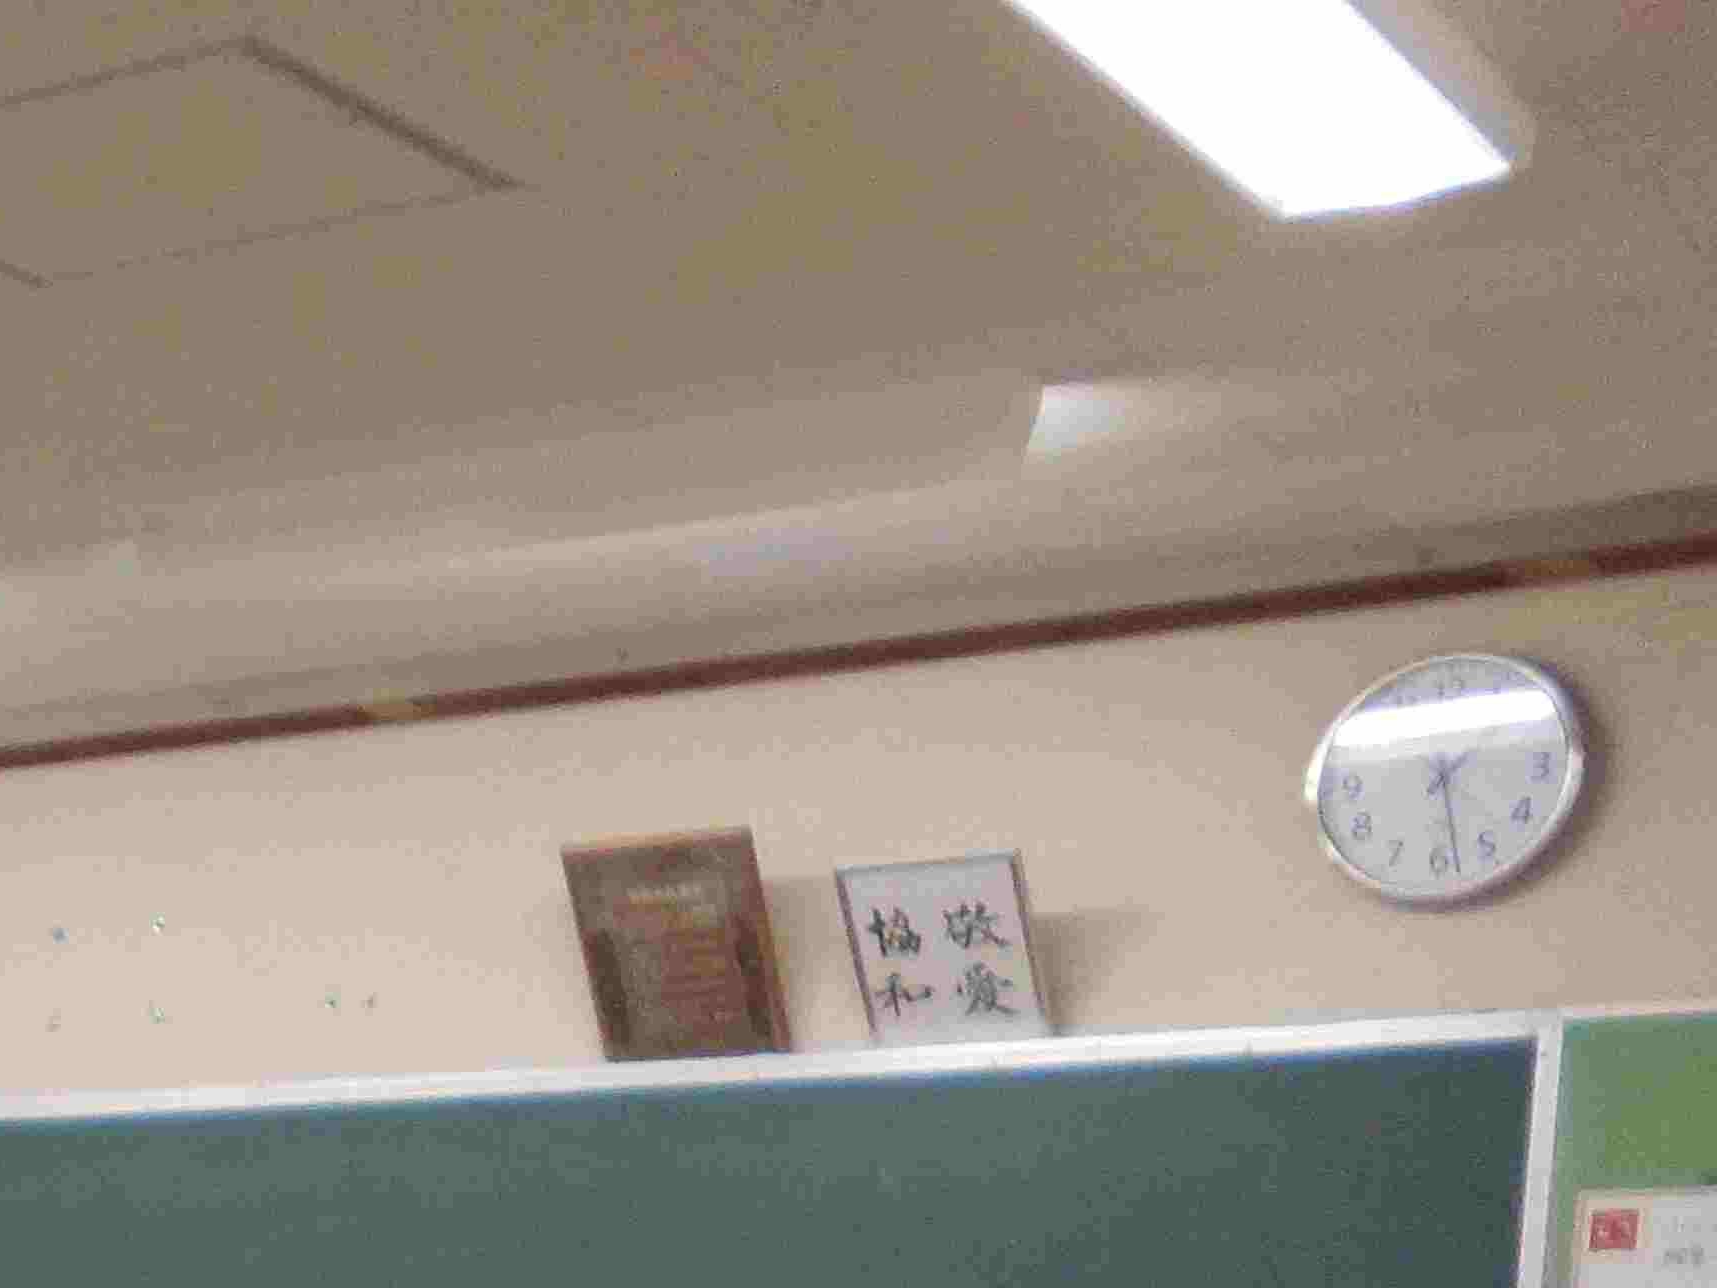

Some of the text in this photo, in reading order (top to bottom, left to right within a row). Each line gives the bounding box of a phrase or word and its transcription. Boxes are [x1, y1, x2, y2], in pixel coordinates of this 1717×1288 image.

[1533, 751, 1551, 780] 3
[1342, 774, 1363, 800] 9
[1512, 796, 1532, 824] 4
[1352, 812, 1372, 840] 8
[1388, 841, 1405, 867] 7
[1476, 831, 1496, 857] 5
[1429, 847, 1449, 877] 6
